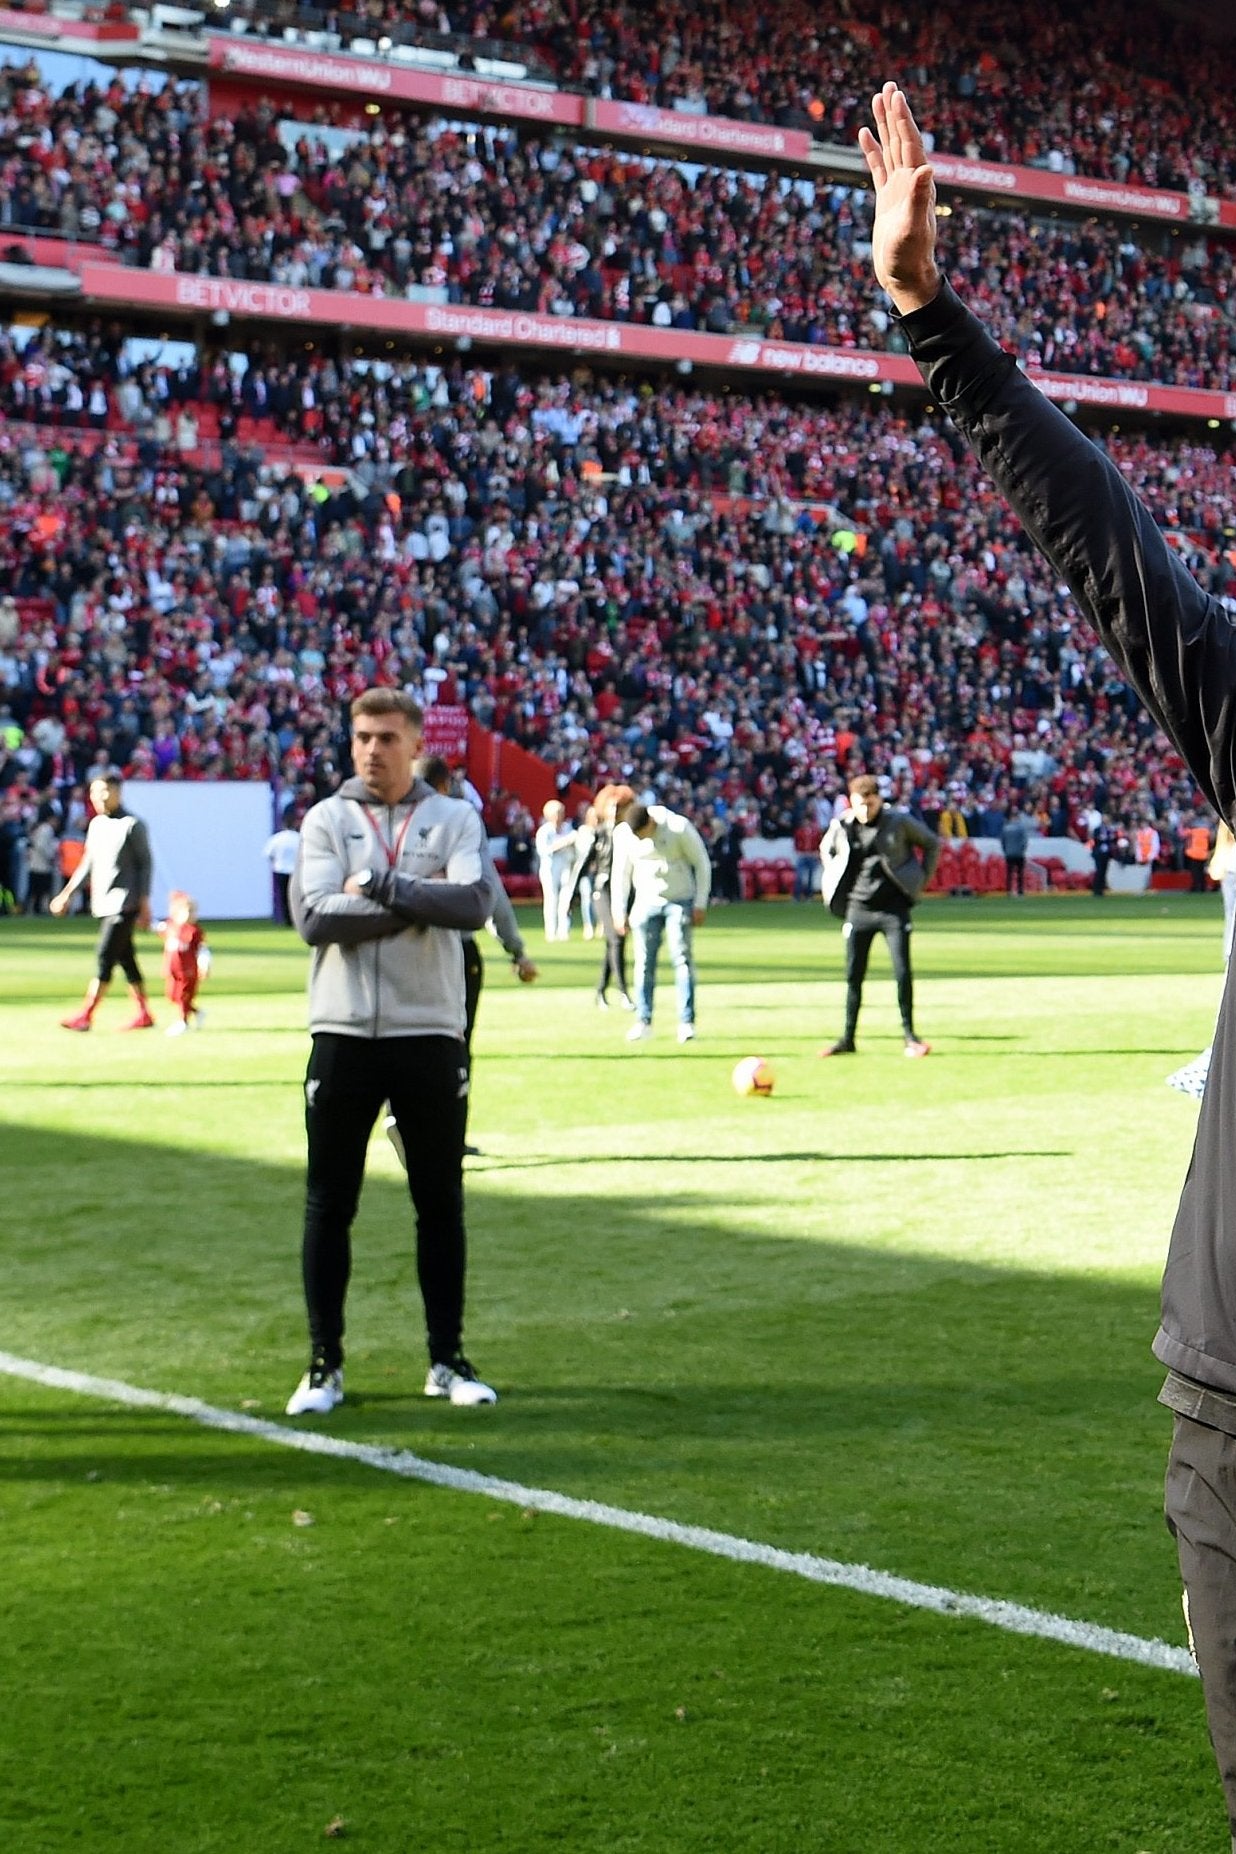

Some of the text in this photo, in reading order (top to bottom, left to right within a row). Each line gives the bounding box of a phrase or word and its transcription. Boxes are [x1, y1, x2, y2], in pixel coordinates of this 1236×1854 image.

[425, 306, 605, 348] Standard Chartered
[762, 348, 800, 368] new
[802, 351, 879, 377] balance
